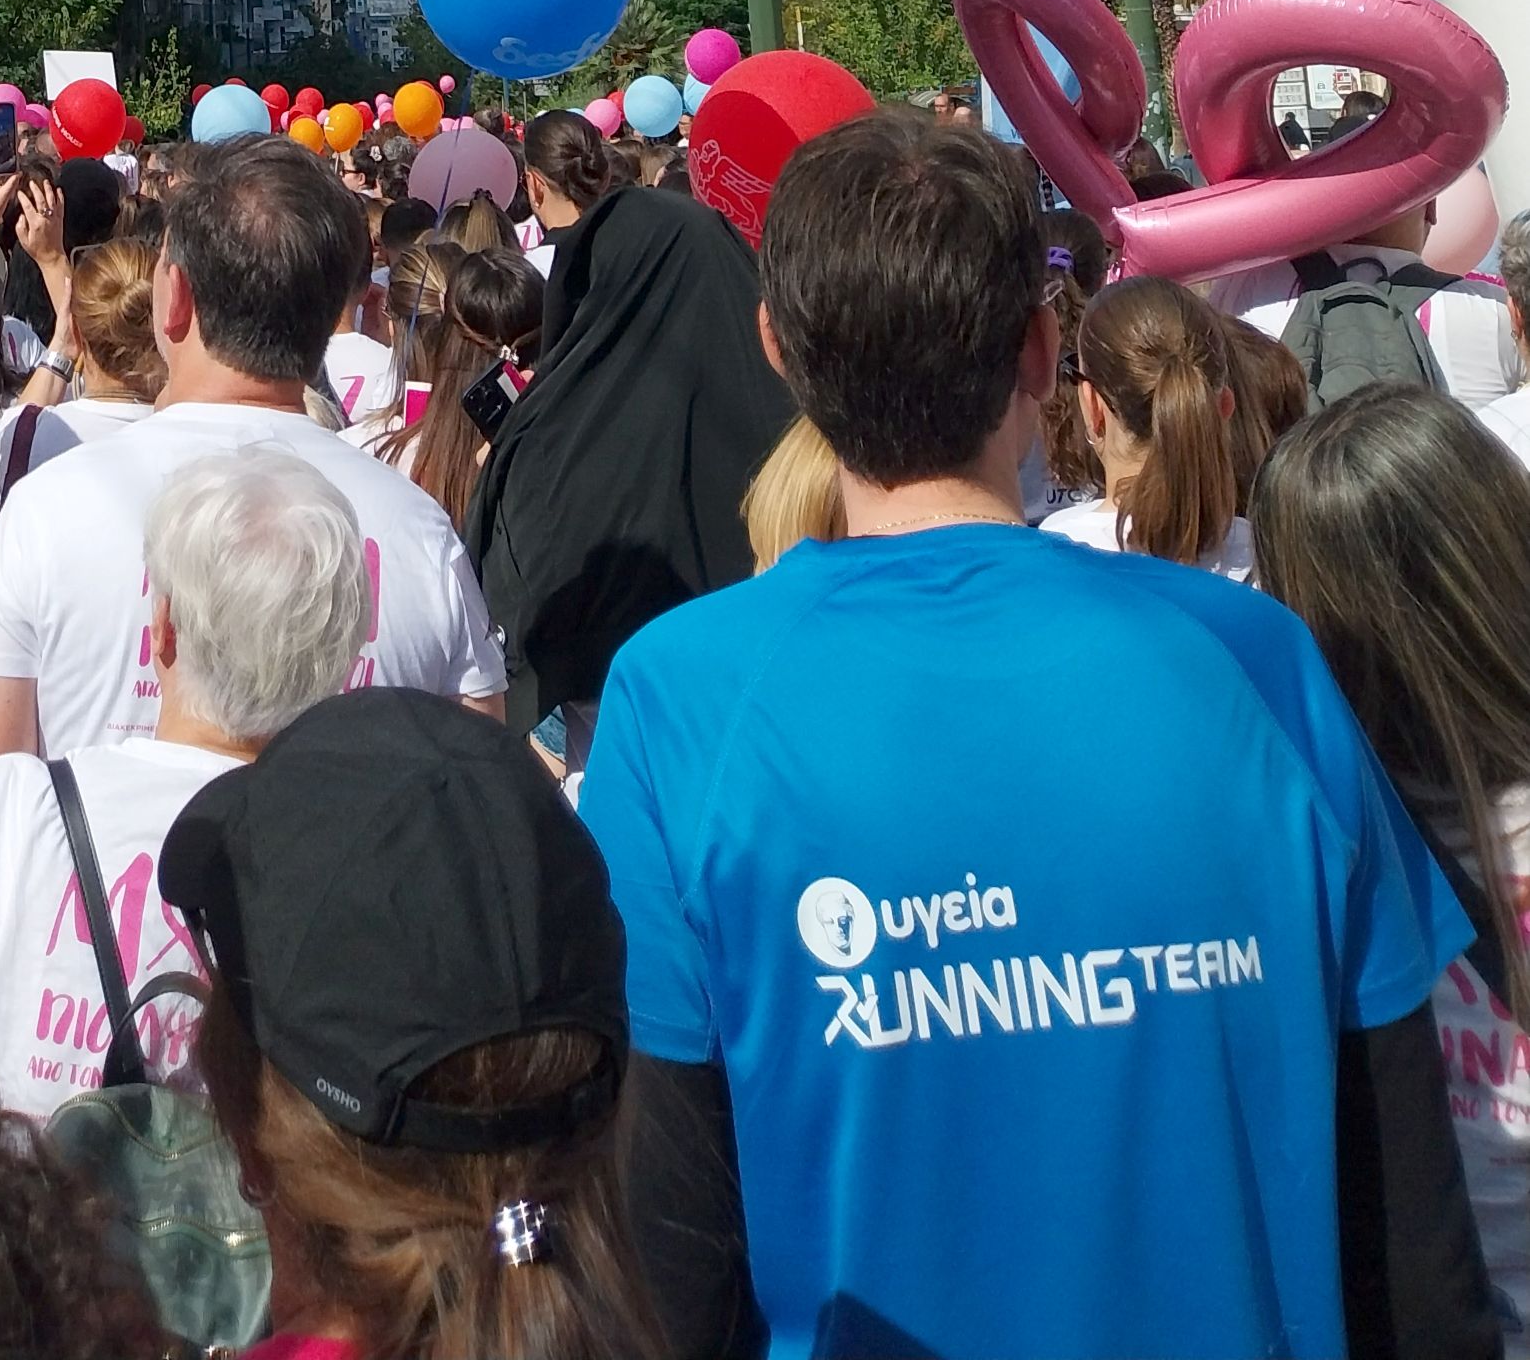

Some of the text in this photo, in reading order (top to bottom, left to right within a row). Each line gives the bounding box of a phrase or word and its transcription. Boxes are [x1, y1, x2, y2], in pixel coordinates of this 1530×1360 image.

[815, 936, 1263, 1048] RUNNING TEAM
[316, 1077, 361, 1113] OYSHO
